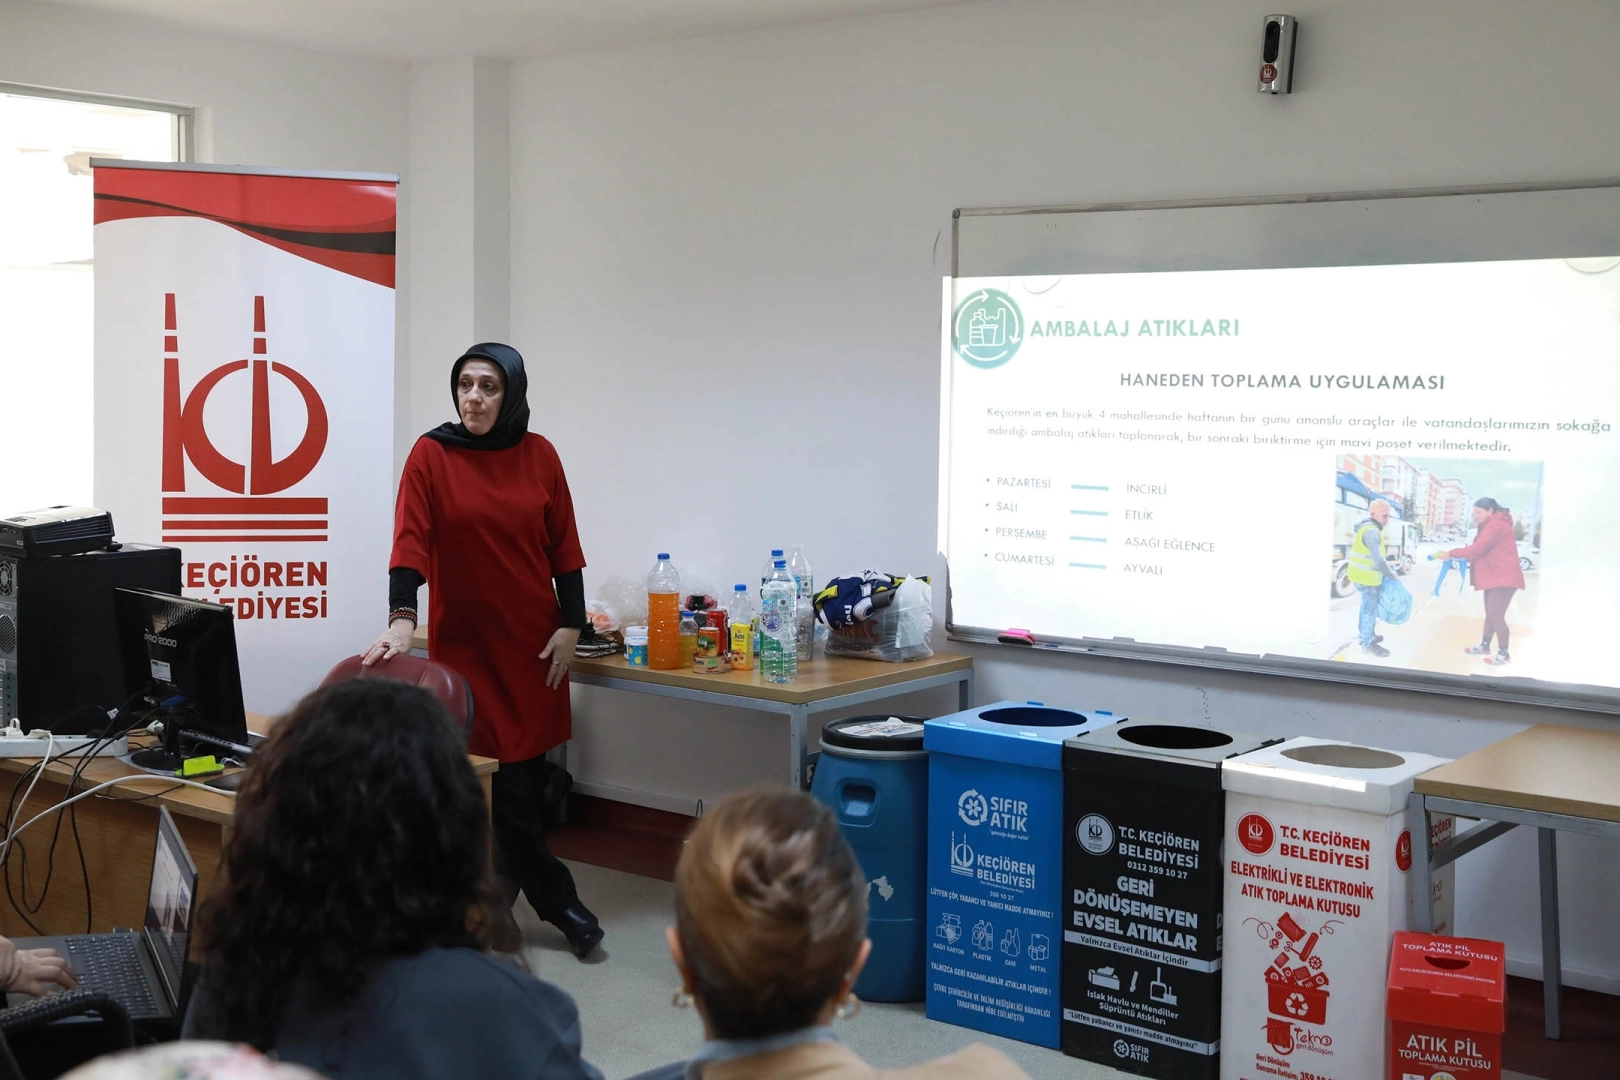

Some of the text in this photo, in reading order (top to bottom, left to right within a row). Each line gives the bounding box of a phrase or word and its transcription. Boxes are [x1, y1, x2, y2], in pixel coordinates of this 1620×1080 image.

[1029, 318, 1240, 337] AMBALAJ ATIKLARI
[1120, 373, 1445, 390] HANEDEN TOPLAMA UYGULAMASI
[1046, 410, 1058, 418] en
[1098, 410, 1105, 418] 4
[1110, 410, 1182, 422] mahallesinde
[1187, 411, 1235, 423] haftanın
[1240, 412, 1256, 423] bir
[1296, 415, 1342, 426] anonslu
[1348, 415, 1396, 429] araçlar
[1402, 416, 1417, 427] ile
[1424, 417, 1550, 432] vatandaşlarımızın
[1556, 419, 1611, 434] sokağa
[1077, 428, 1115, 439] atıkları
[1119, 430, 1184, 443] toplanarak,
[1187, 432, 1203, 442] bir
[1316, 436, 1336, 449] için
[1340, 437, 1371, 448] mavi
[1376, 439, 1412, 451] poşet
[1417, 439, 1511, 452] verilmektedir.
[996, 476, 1051, 489] PAZARTESİ
[1126, 482, 1167, 495] İNCİRLİ
[996, 501, 1018, 512] SALI
[1125, 507, 1154, 521] ETLİK
[995, 526, 1047, 540] PERŞEMBE
[1124, 536, 1216, 553] AŞAĞI EĞLENCE
[994, 552, 1055, 566] CUMARTESİ
[181, 554, 328, 595] EÇİÖREN
[1123, 563, 1163, 576] AYVALI
[158, 636, 177, 648] 2000
[990, 796, 1028, 816] SIFIR
[990, 812, 1028, 833] ATIK
[1431, 817, 1452, 838] EÇİÖREN
[1118, 825, 1200, 852] T.C. KEÇİÖREN
[1280, 825, 1370, 852] T.C. KEÇİÖREN
[977, 854, 1035, 876] KEÇİÖREN
[1119, 842, 1199, 869] BELEDİYESİ
[1280, 842, 1370, 871] BELEDİYESİ
[977, 868, 1035, 889] BELEDİYESİ
[1127, 860, 1188, 880] 0312 359 10 27
[1230, 860, 1375, 900] ELEKTRİKLİ VE ELEKTRONİK
[1117, 875, 1154, 898] GERİ
[980, 899, 986, 907] VE
[987, 900, 1004, 910] YANICI
[1004, 903, 1022, 913] MADDE
[1022, 906, 1051, 919] ATMAYINIZ
[1073, 887, 1198, 929] DÖNÜŞEMEYEN
[1241, 882, 1361, 919] ATIK TOPLAMA KUTUSU
[1073, 910, 1124, 935] EVSEL
[1126, 921, 1198, 952] ATIKLAR
[1080, 935, 1189, 966] Yalnızca Evsel Atıklar İçindir
[1402, 943, 1498, 961] TOPLAMA KUTUSU
[1429, 941, 1452, 949] ATIK
[1004, 959, 1016, 967] CAM
[1029, 964, 1047, 973] METAL
[954, 967, 966, 977] GERİ
[1004, 980, 1027, 991] ATIKLAR
[973, 993, 979, 1001] VE
[1087, 989, 1180, 1020] Islak Havlu ve Mendiller
[1099, 1001, 1166, 1026] Süprüntü Atıkları
[1091, 1016, 1115, 1028] yabancı
[1115, 1022, 1123, 1031] ve
[1123, 1025, 1142, 1036] yanıcı
[1143, 1029, 1164, 1041] madde
[1294, 1027, 1333, 1046] Tekno
[1130, 1043, 1150, 1055] SIFIR
[1406, 1034, 1483, 1058] ATIK PİL
[1130, 1051, 1149, 1063] ATIK
[1256, 1053, 1267, 1062] Geri
[1398, 1049, 1447, 1064] TOPLAMA
[1449, 1055, 1491, 1070] KUTUSU
